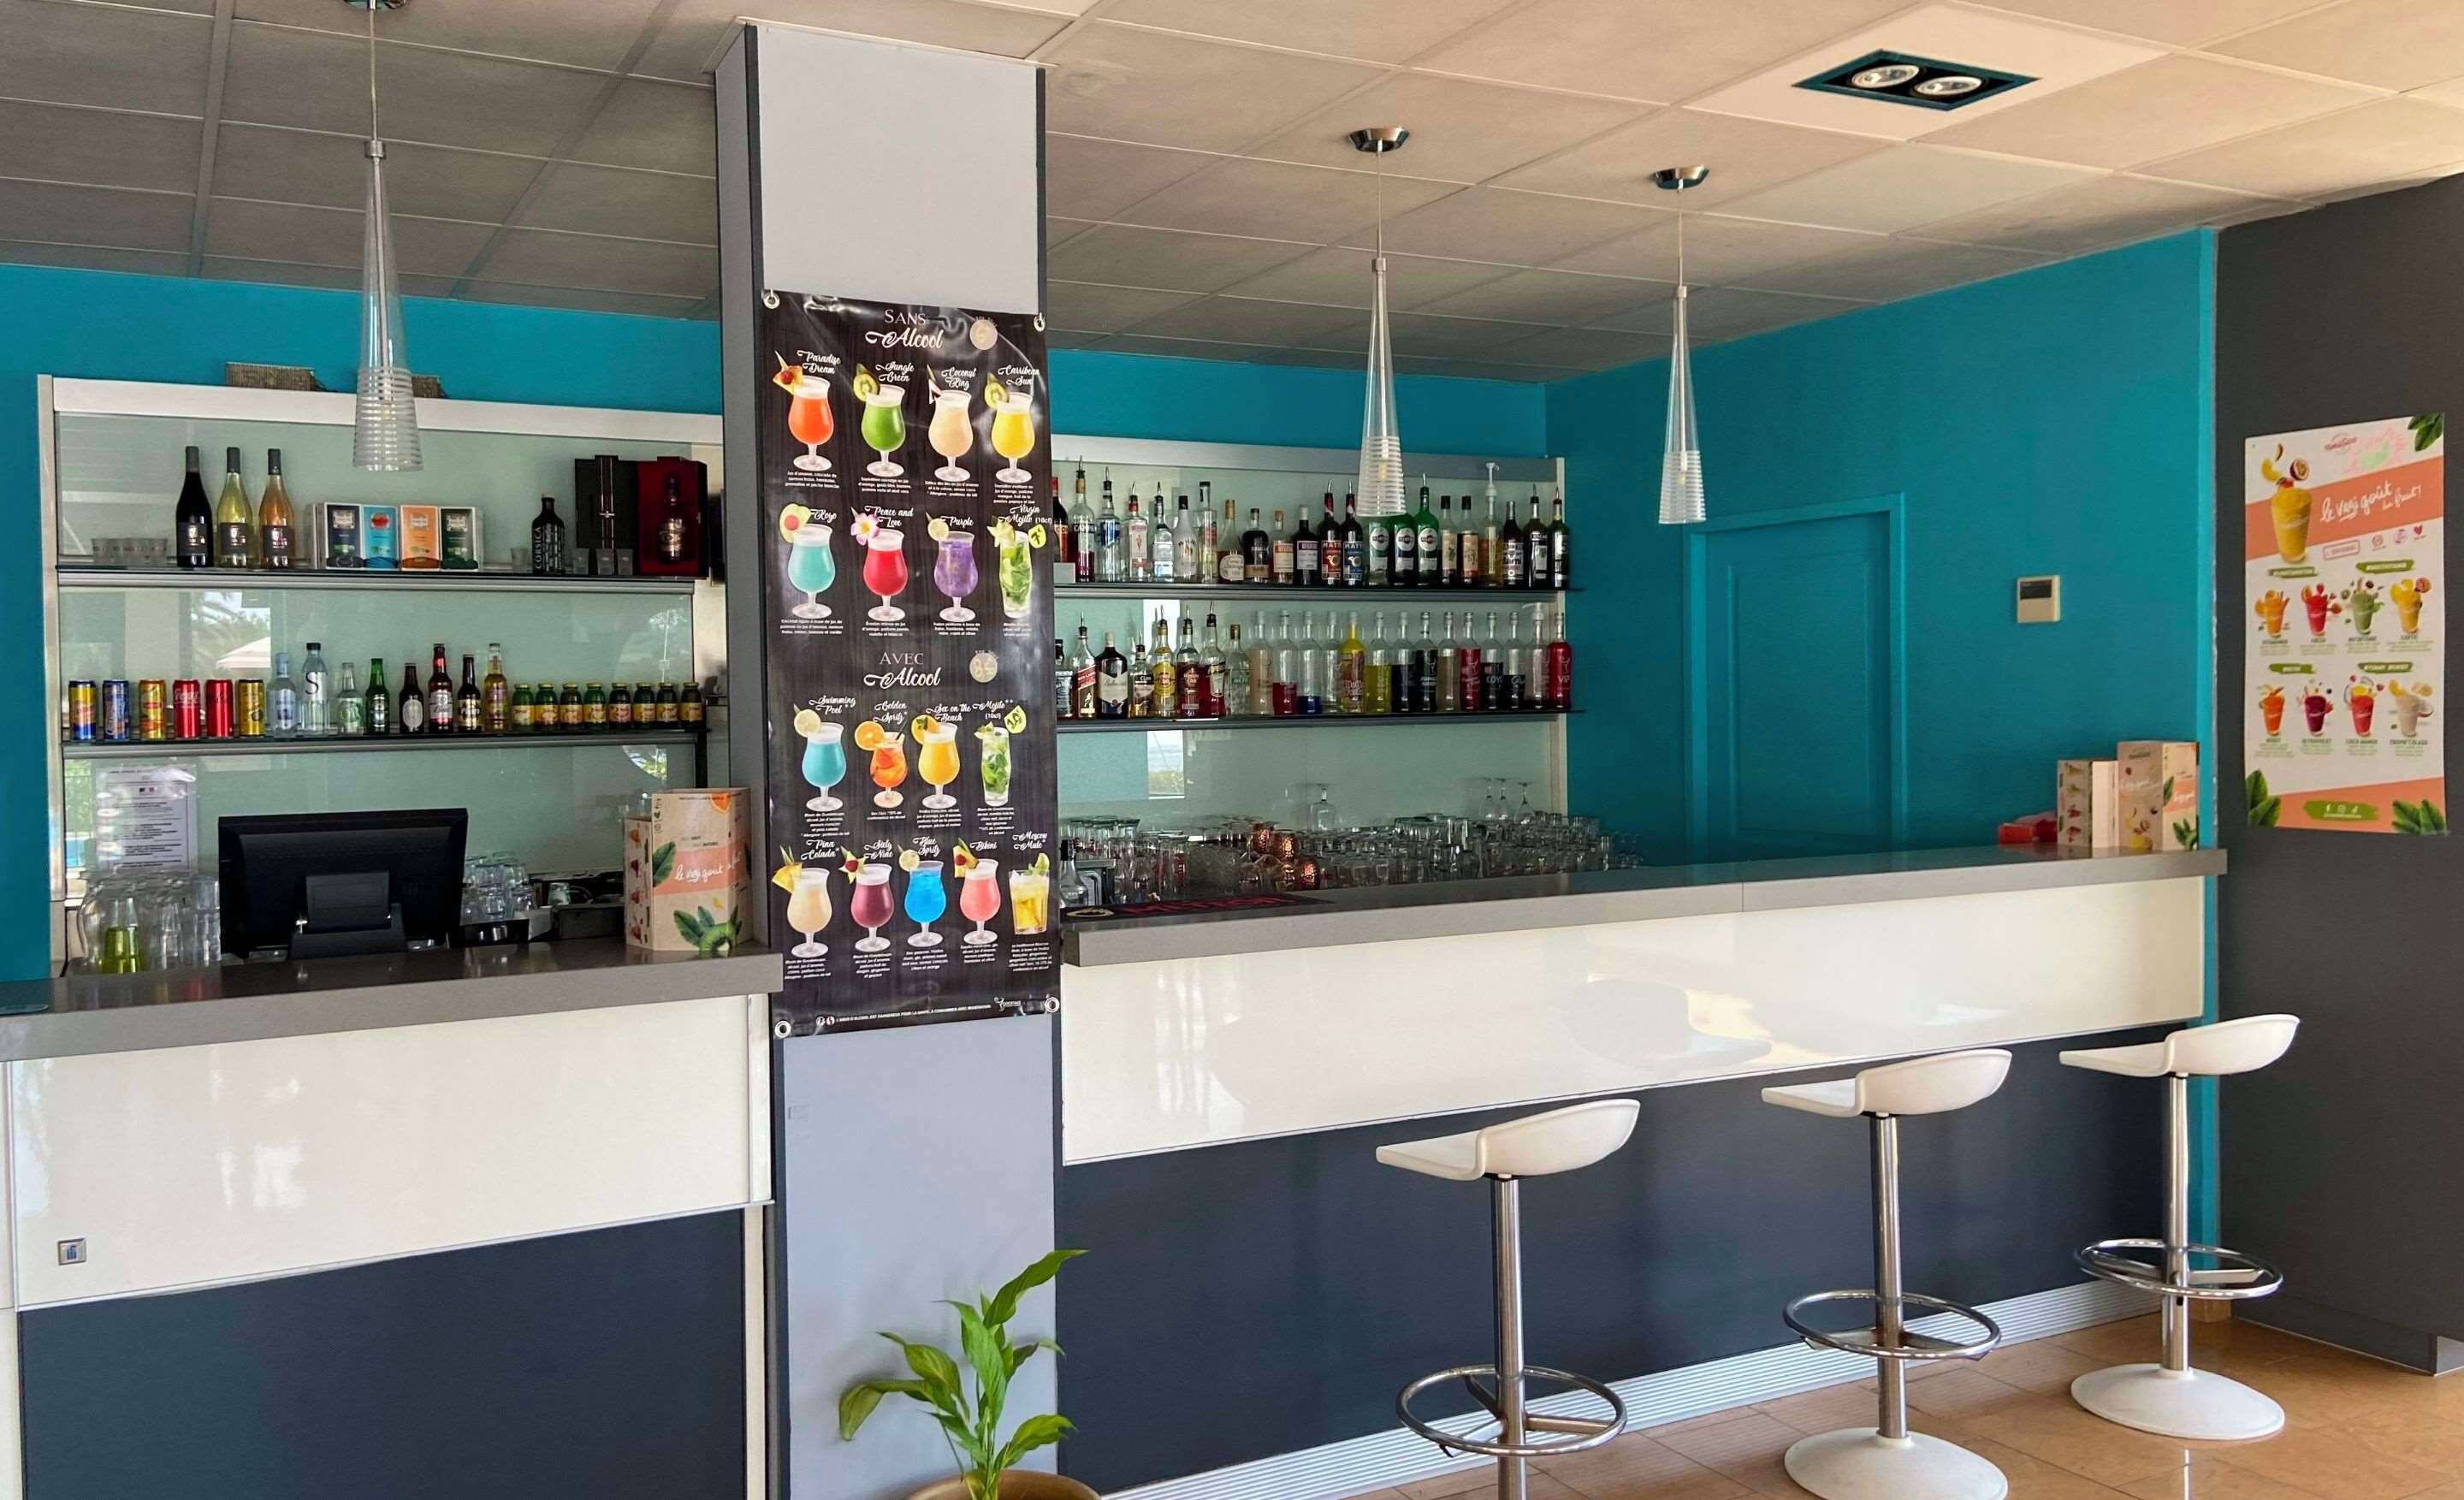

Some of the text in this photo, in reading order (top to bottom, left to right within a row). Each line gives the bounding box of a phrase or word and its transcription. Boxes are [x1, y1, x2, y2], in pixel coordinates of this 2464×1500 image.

[884, 309, 927, 325] SANS
[865, 327, 945, 349] Alcool
[797, 349, 841, 365] Paradise
[802, 362, 836, 375] Dream
[874, 360, 915, 373] Jungle
[940, 366, 977, 378] Coconut
[878, 371, 910, 383] Green
[864, 506, 914, 519] Peace and
[1010, 505, 1041, 518] Virgin
[2319, 496, 2336, 522] le
[878, 517, 903, 528] Love
[940, 515, 974, 529] Purple
[534, 525, 542, 570] CORSICA
[879, 650, 924, 665] AVEC
[863, 667, 942, 690] Alcool
[808, 694, 856, 708] Swimming
[874, 700, 908, 712] Golden
[959, 703, 972, 713] the
[969, 841, 998, 851] Bikini
